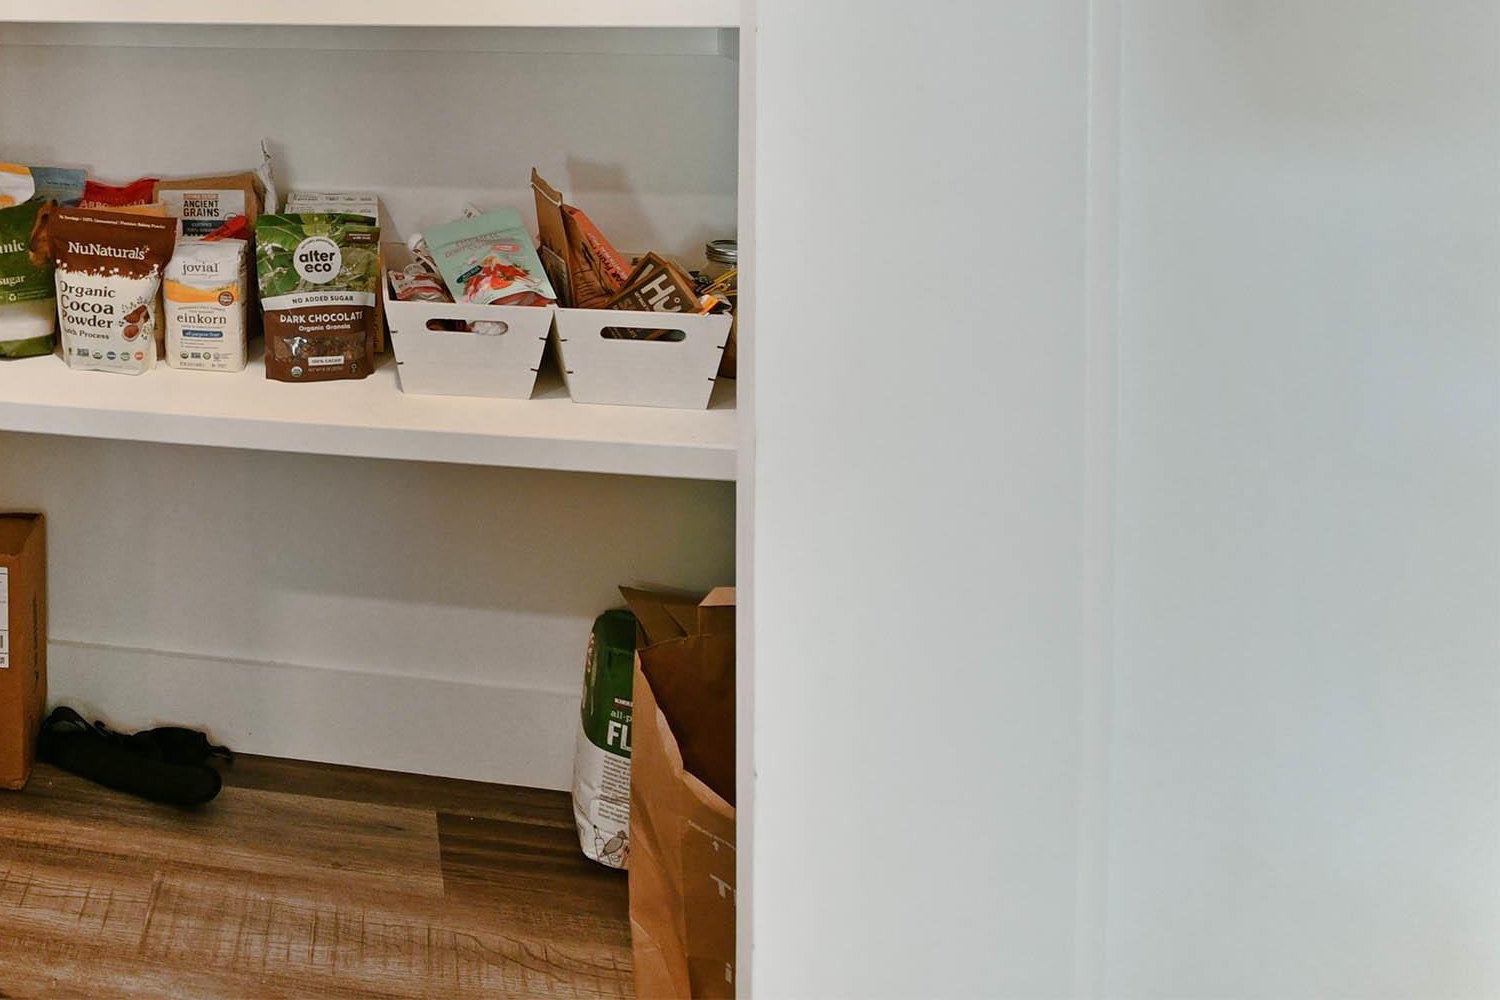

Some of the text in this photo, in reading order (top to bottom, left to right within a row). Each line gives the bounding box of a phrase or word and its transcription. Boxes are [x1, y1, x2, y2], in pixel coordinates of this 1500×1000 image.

[183, 200, 219, 208] ANCIENT
[183, 208, 220, 217] GRAINS
[68, 241, 145, 260] NuNaturals
[299, 250, 335, 263] alter
[182, 261, 219, 275] jovial
[304, 263, 332, 273] eco
[60, 280, 116, 298] Organic
[330, 294, 354, 302] SUGAR
[61, 294, 114, 315] Cocoa
[62, 309, 113, 329] Powder
[177, 313, 227, 324] einkorn
[280, 314, 306, 323] DARK
[299, 324, 324, 332] Organic
[80, 330, 110, 340] Process
